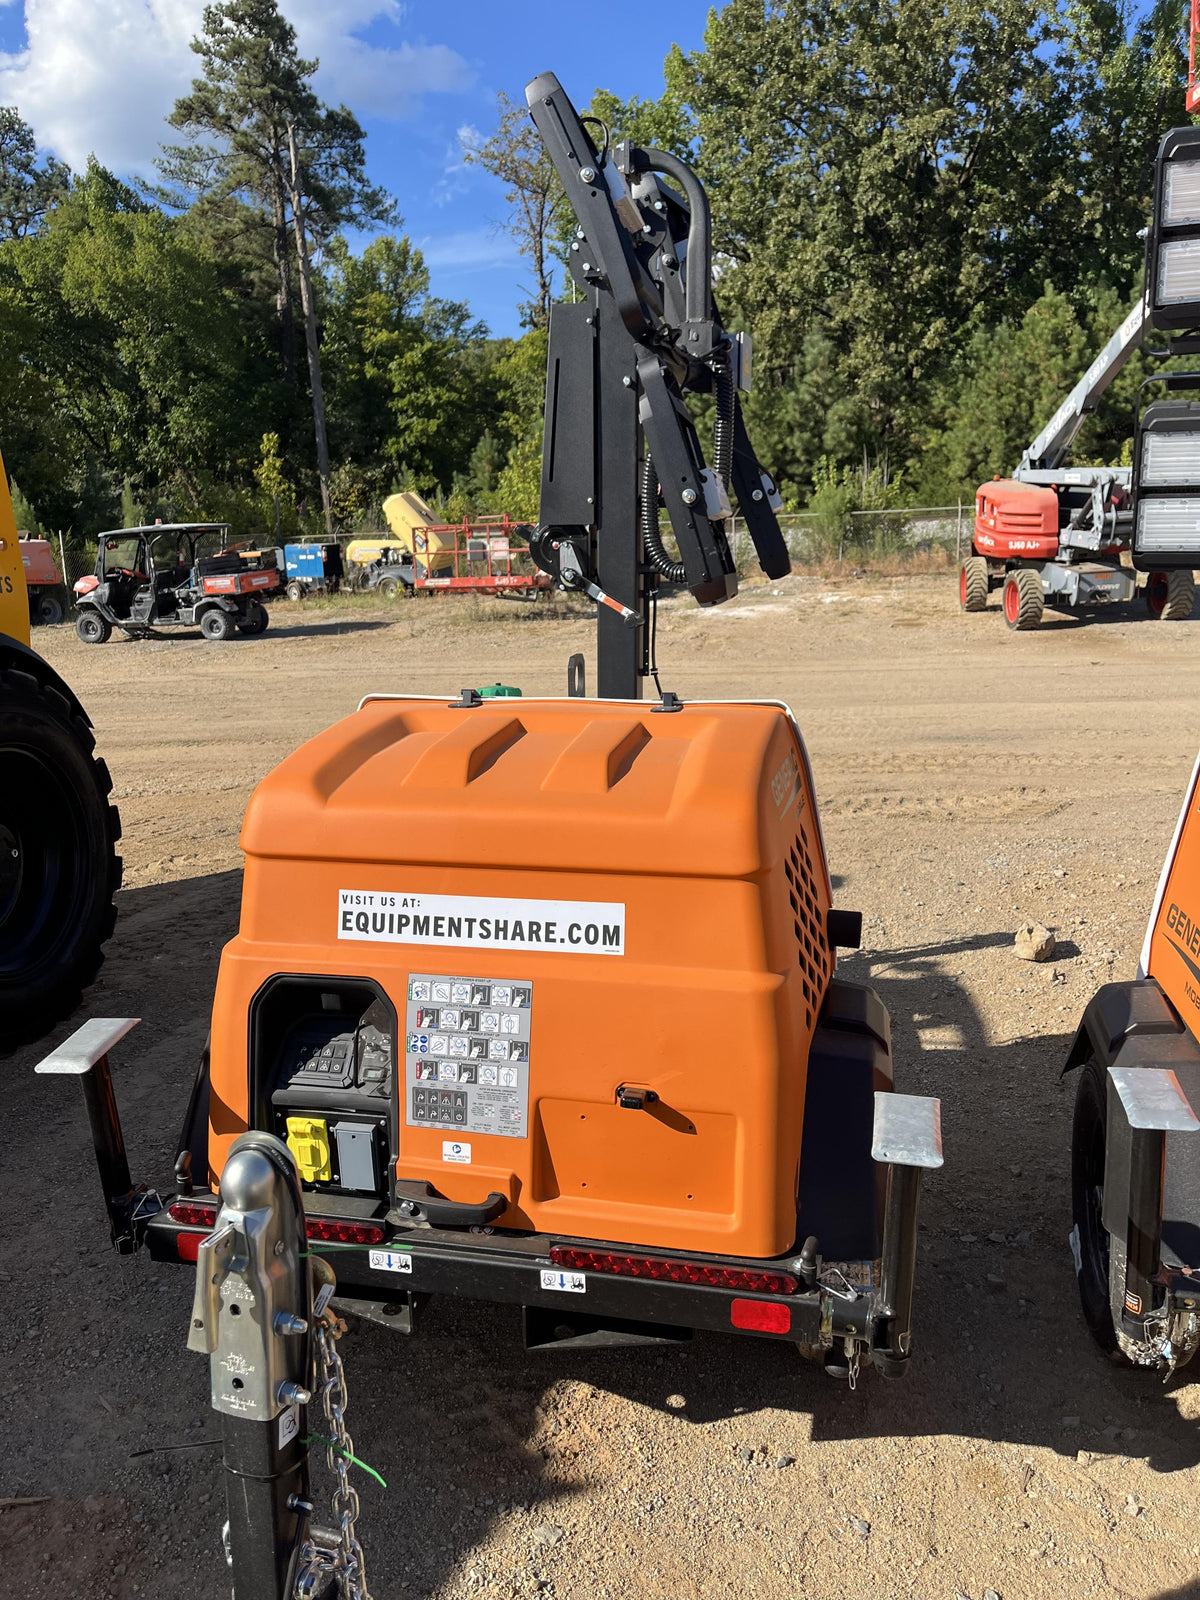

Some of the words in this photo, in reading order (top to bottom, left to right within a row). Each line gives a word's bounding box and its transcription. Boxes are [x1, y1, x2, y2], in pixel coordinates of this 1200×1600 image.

[342, 894, 374, 906] VISIT
[381, 896, 396, 907] US
[402, 898, 420, 908] AT:
[342, 910, 621, 946] EQUIPMENTSHARE.COM
